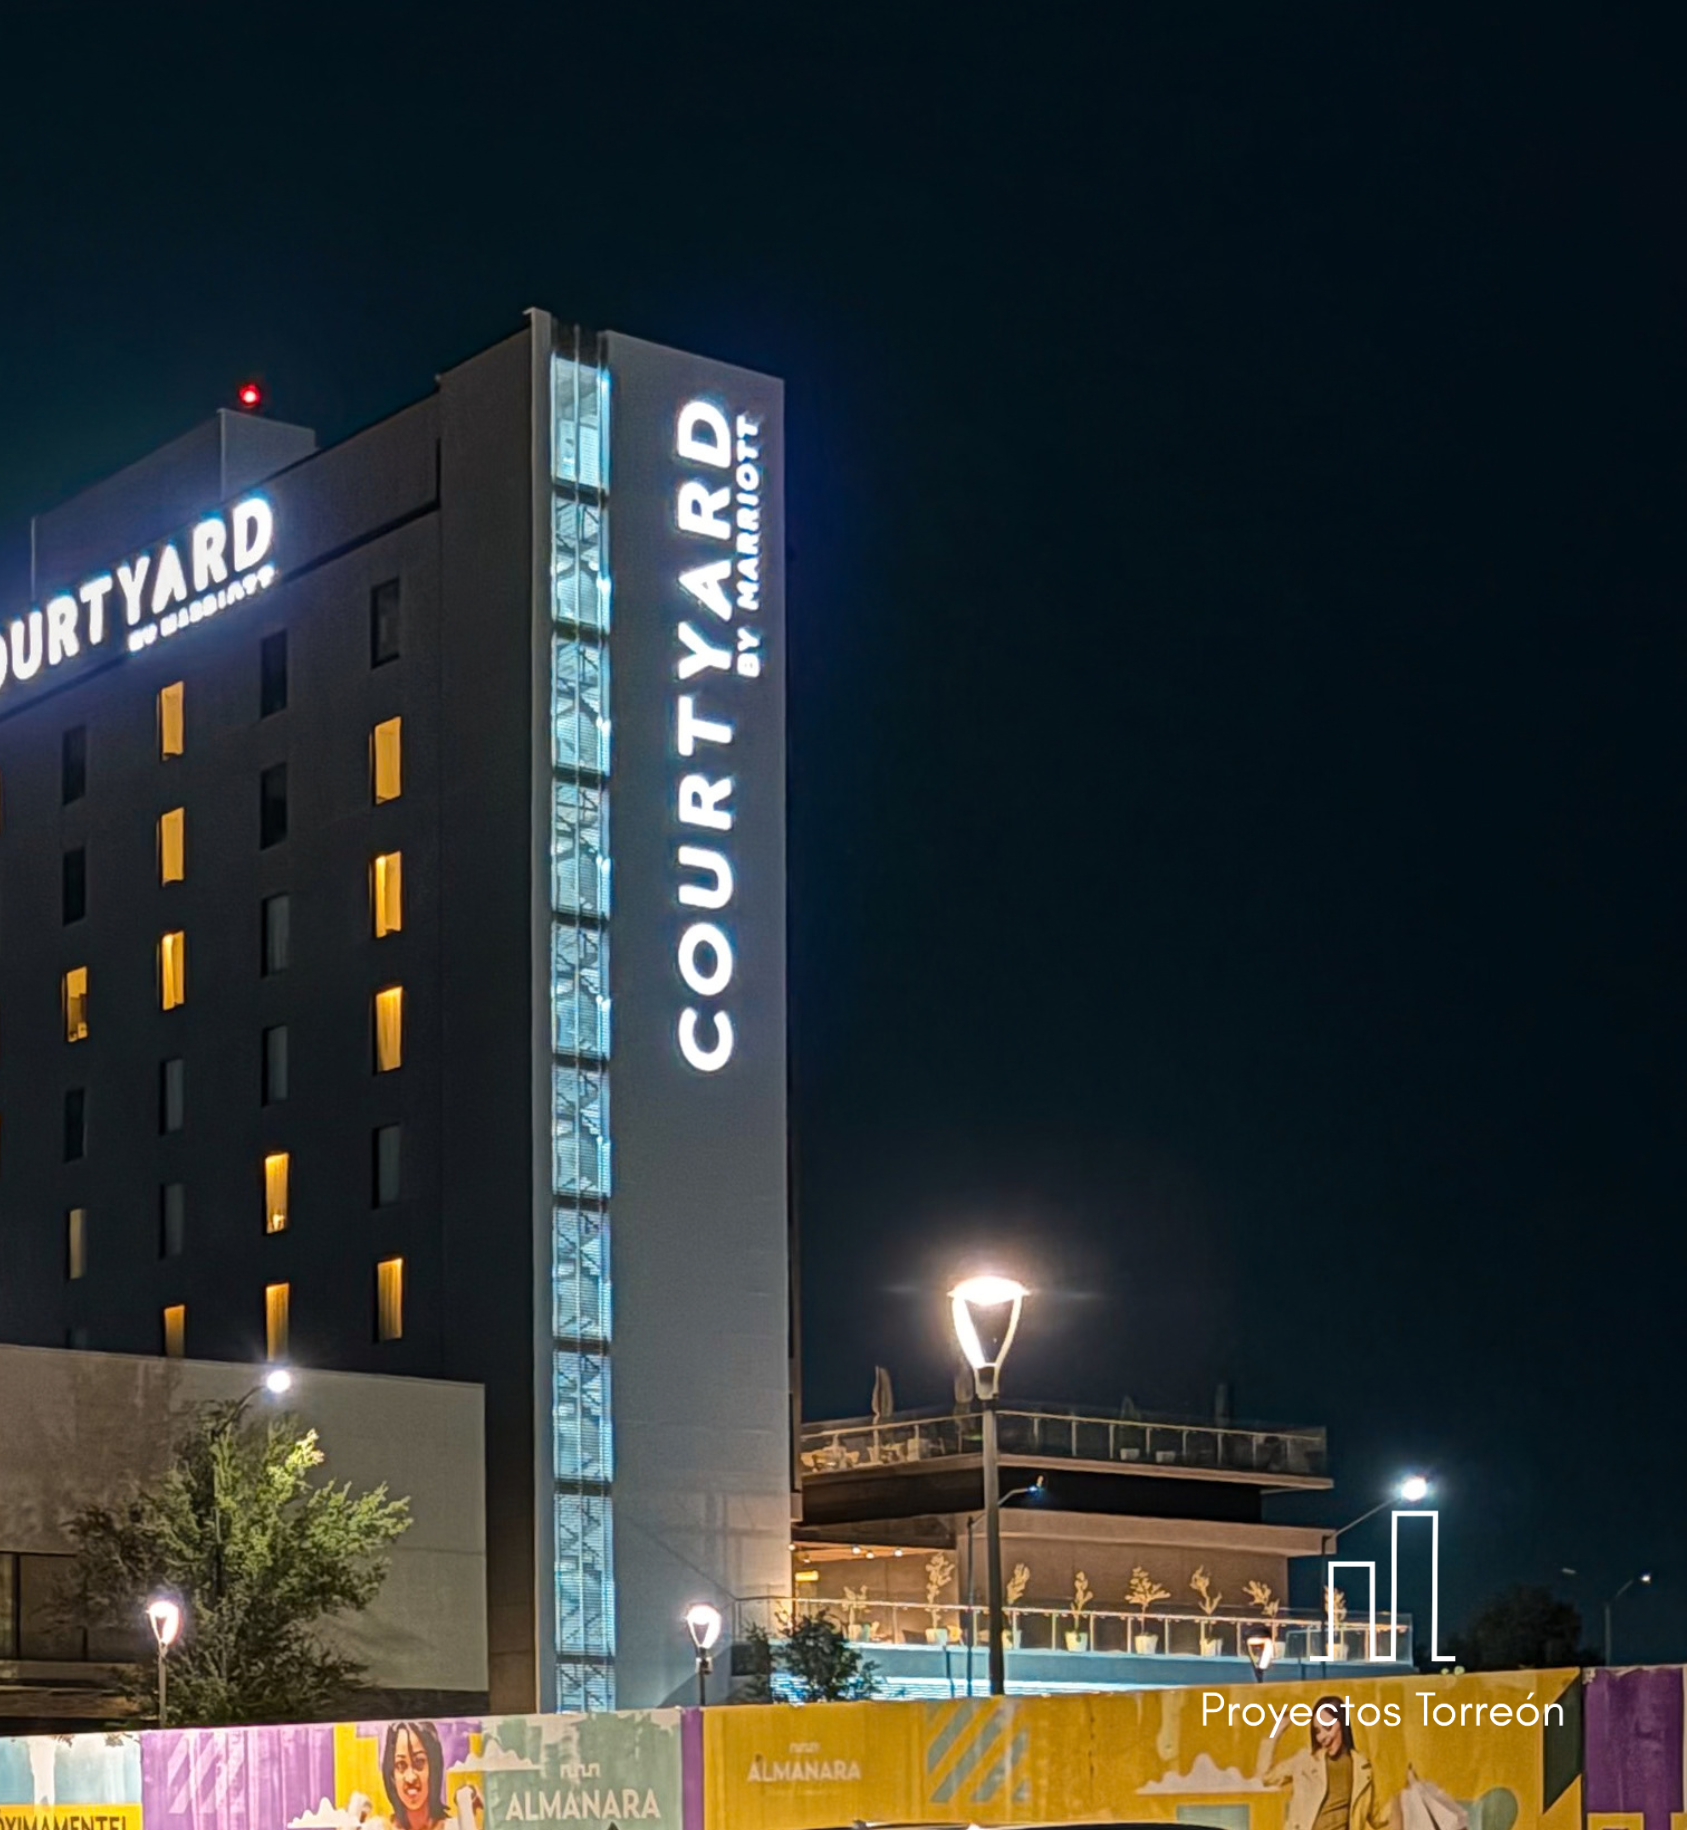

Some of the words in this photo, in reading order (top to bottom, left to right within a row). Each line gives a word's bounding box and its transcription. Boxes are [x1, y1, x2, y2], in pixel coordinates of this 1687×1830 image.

[736, 413, 760, 611] MARRIOTT
[736, 627, 760, 678] BY
[677, 399, 734, 1072] COURTYARD
[747, 1759, 861, 1782] ALMANARA
[505, 1788, 662, 1821] ALMANARA
